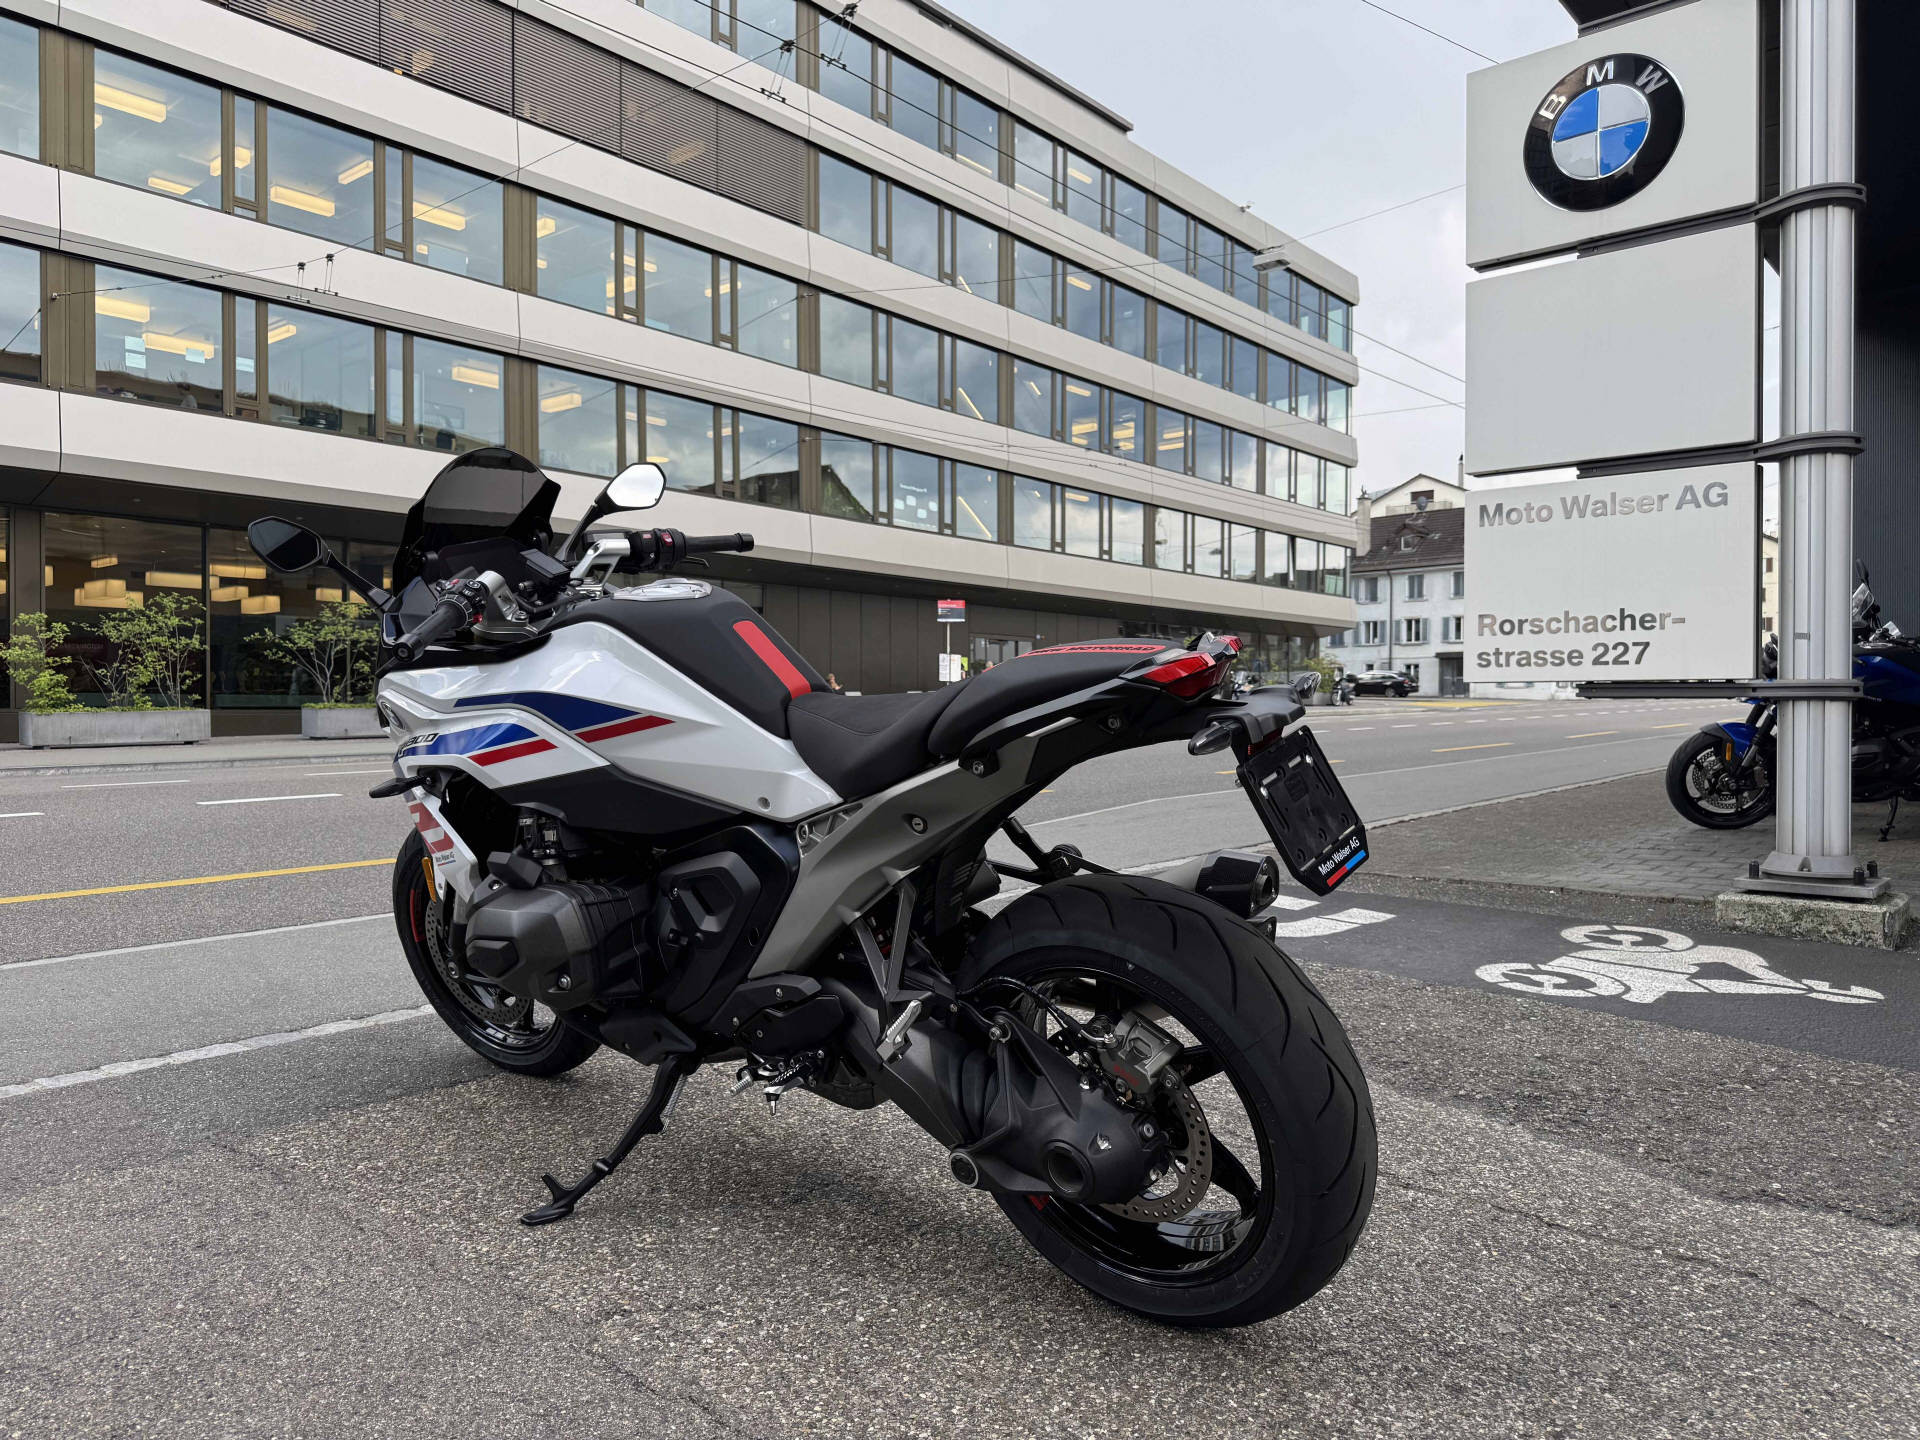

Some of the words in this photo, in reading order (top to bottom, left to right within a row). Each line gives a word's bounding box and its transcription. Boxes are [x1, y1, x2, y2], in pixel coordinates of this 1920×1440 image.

[1538, 60, 1669, 120] BMW
[1479, 503, 1553, 528] Moto
[1560, 492, 1669, 520] Walser
[1675, 481, 1729, 511] AG
[1477, 607, 1686, 637] Rorschacher-
[1476, 647, 1584, 669] strasse
[1591, 641, 1651, 666] 227
[1318, 859, 1335, 876] Moto
[1331, 845, 1351, 864] Walser
[1349, 836, 1360, 850] AG
